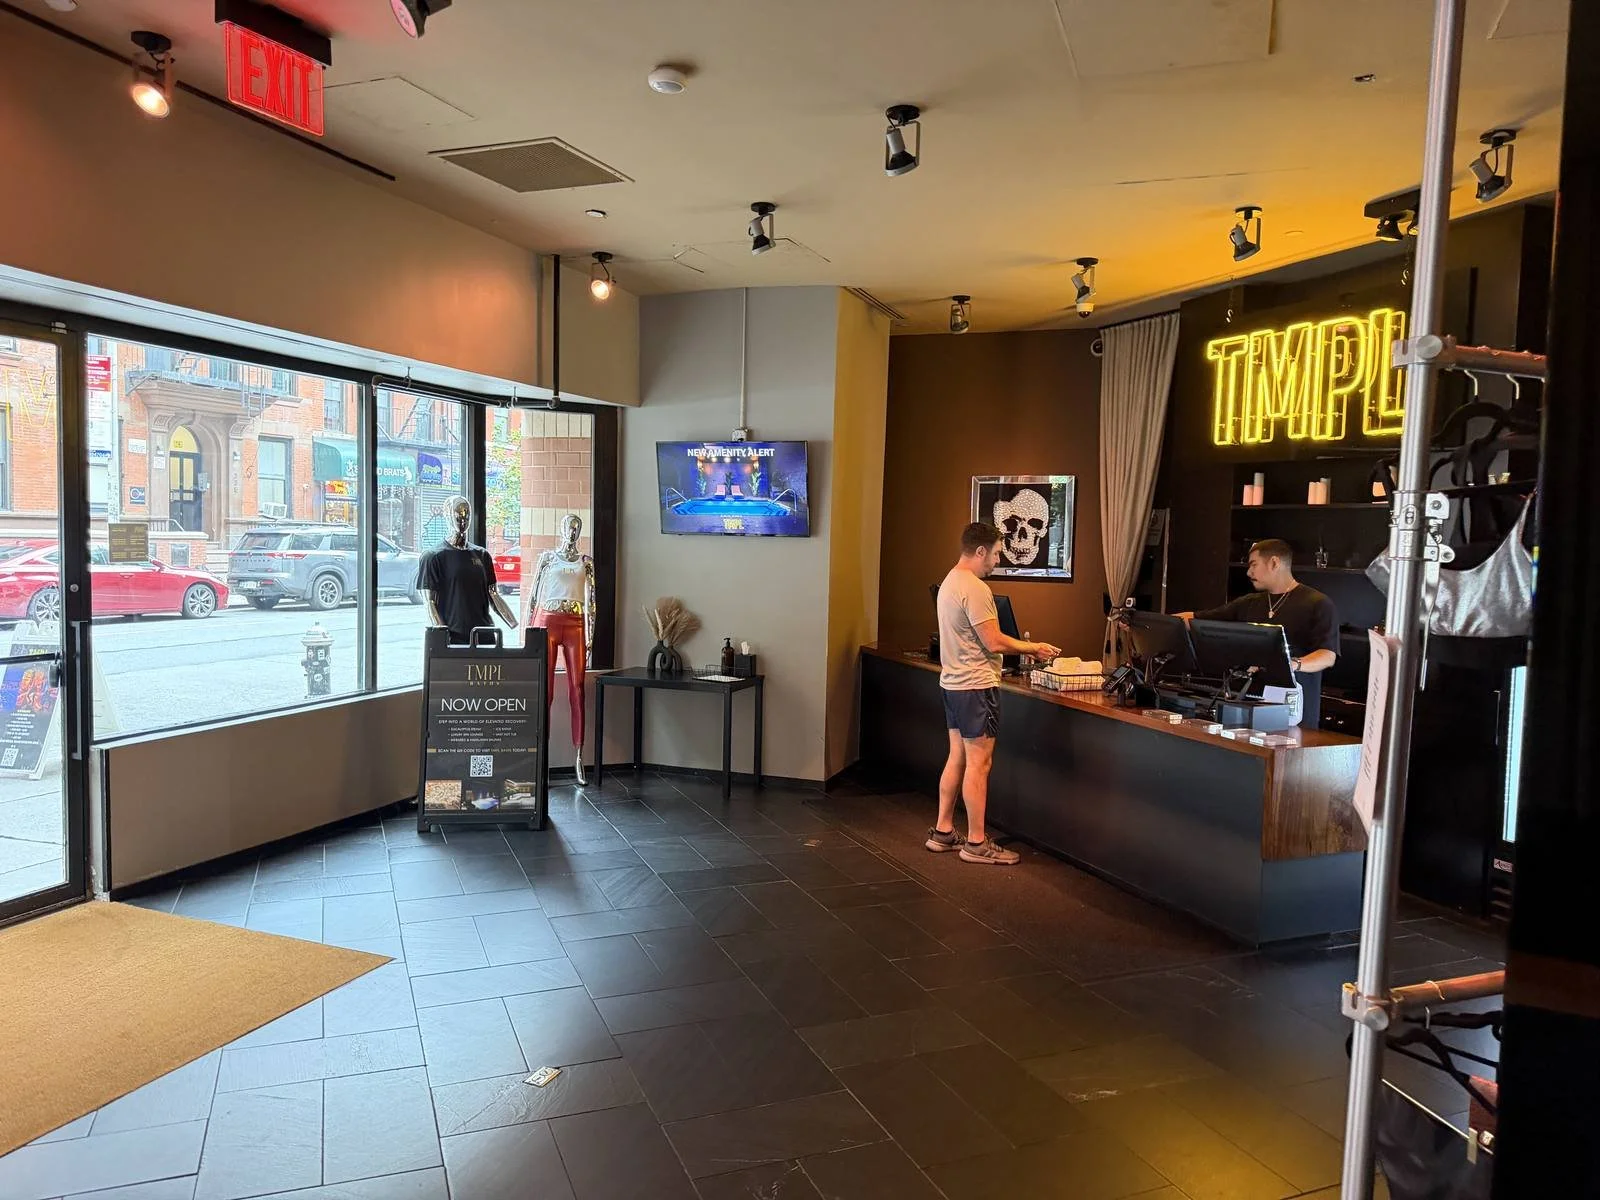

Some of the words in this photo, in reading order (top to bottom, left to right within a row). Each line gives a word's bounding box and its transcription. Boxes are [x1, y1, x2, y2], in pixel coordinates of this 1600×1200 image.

[241, 31, 313, 126] EXIT
[1207, 308, 1407, 446] TMPL
[687, 448, 707, 458] NEW
[709, 447, 746, 458] AMENITY
[747, 447, 775, 458] ALERT
[383, 467, 405, 477] BRATS
[464, 664, 505, 681] TMPL
[441, 698, 481, 711] NOW
[484, 698, 527, 711] OPEN
